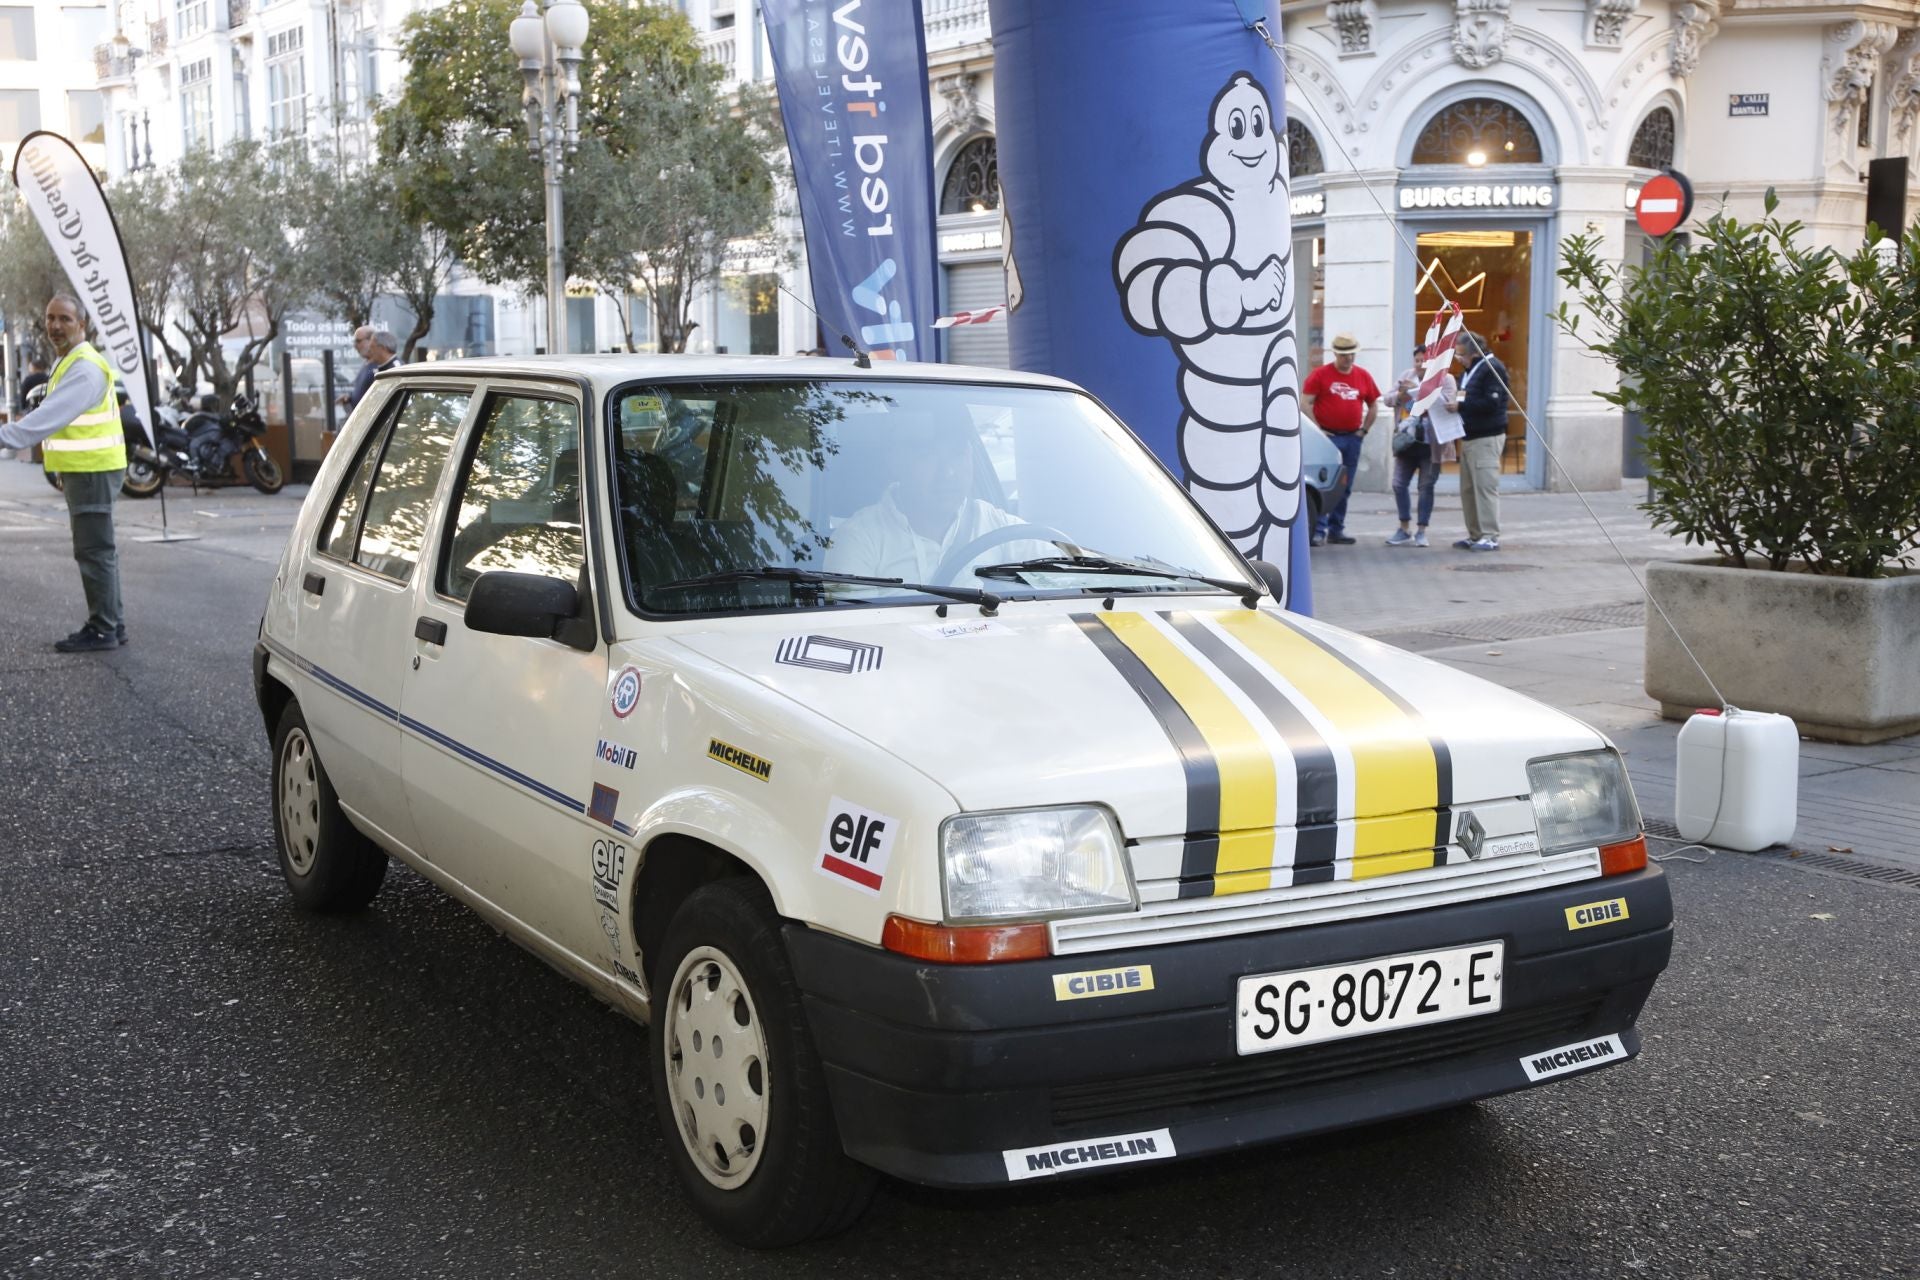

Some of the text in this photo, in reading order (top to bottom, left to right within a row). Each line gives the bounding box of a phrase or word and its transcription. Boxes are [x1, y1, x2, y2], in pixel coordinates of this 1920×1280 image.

[1731, 106, 1767, 115] MANTILLA
[1742, 94, 1768, 103] CALLE
[1400, 185, 1553, 208] BURGER KING
[284, 320, 316, 332] Todo
[317, 322, 333, 332] es
[286, 333, 332, 346] cuando
[596, 740, 626, 766] Mobil
[709, 740, 772, 777] MICHELIN
[829, 813, 886, 863] elf
[591, 839, 626, 886] elf
[1531, 1040, 1615, 1074] MICHELIN
[1025, 1137, 1158, 1171] MICHELIN
